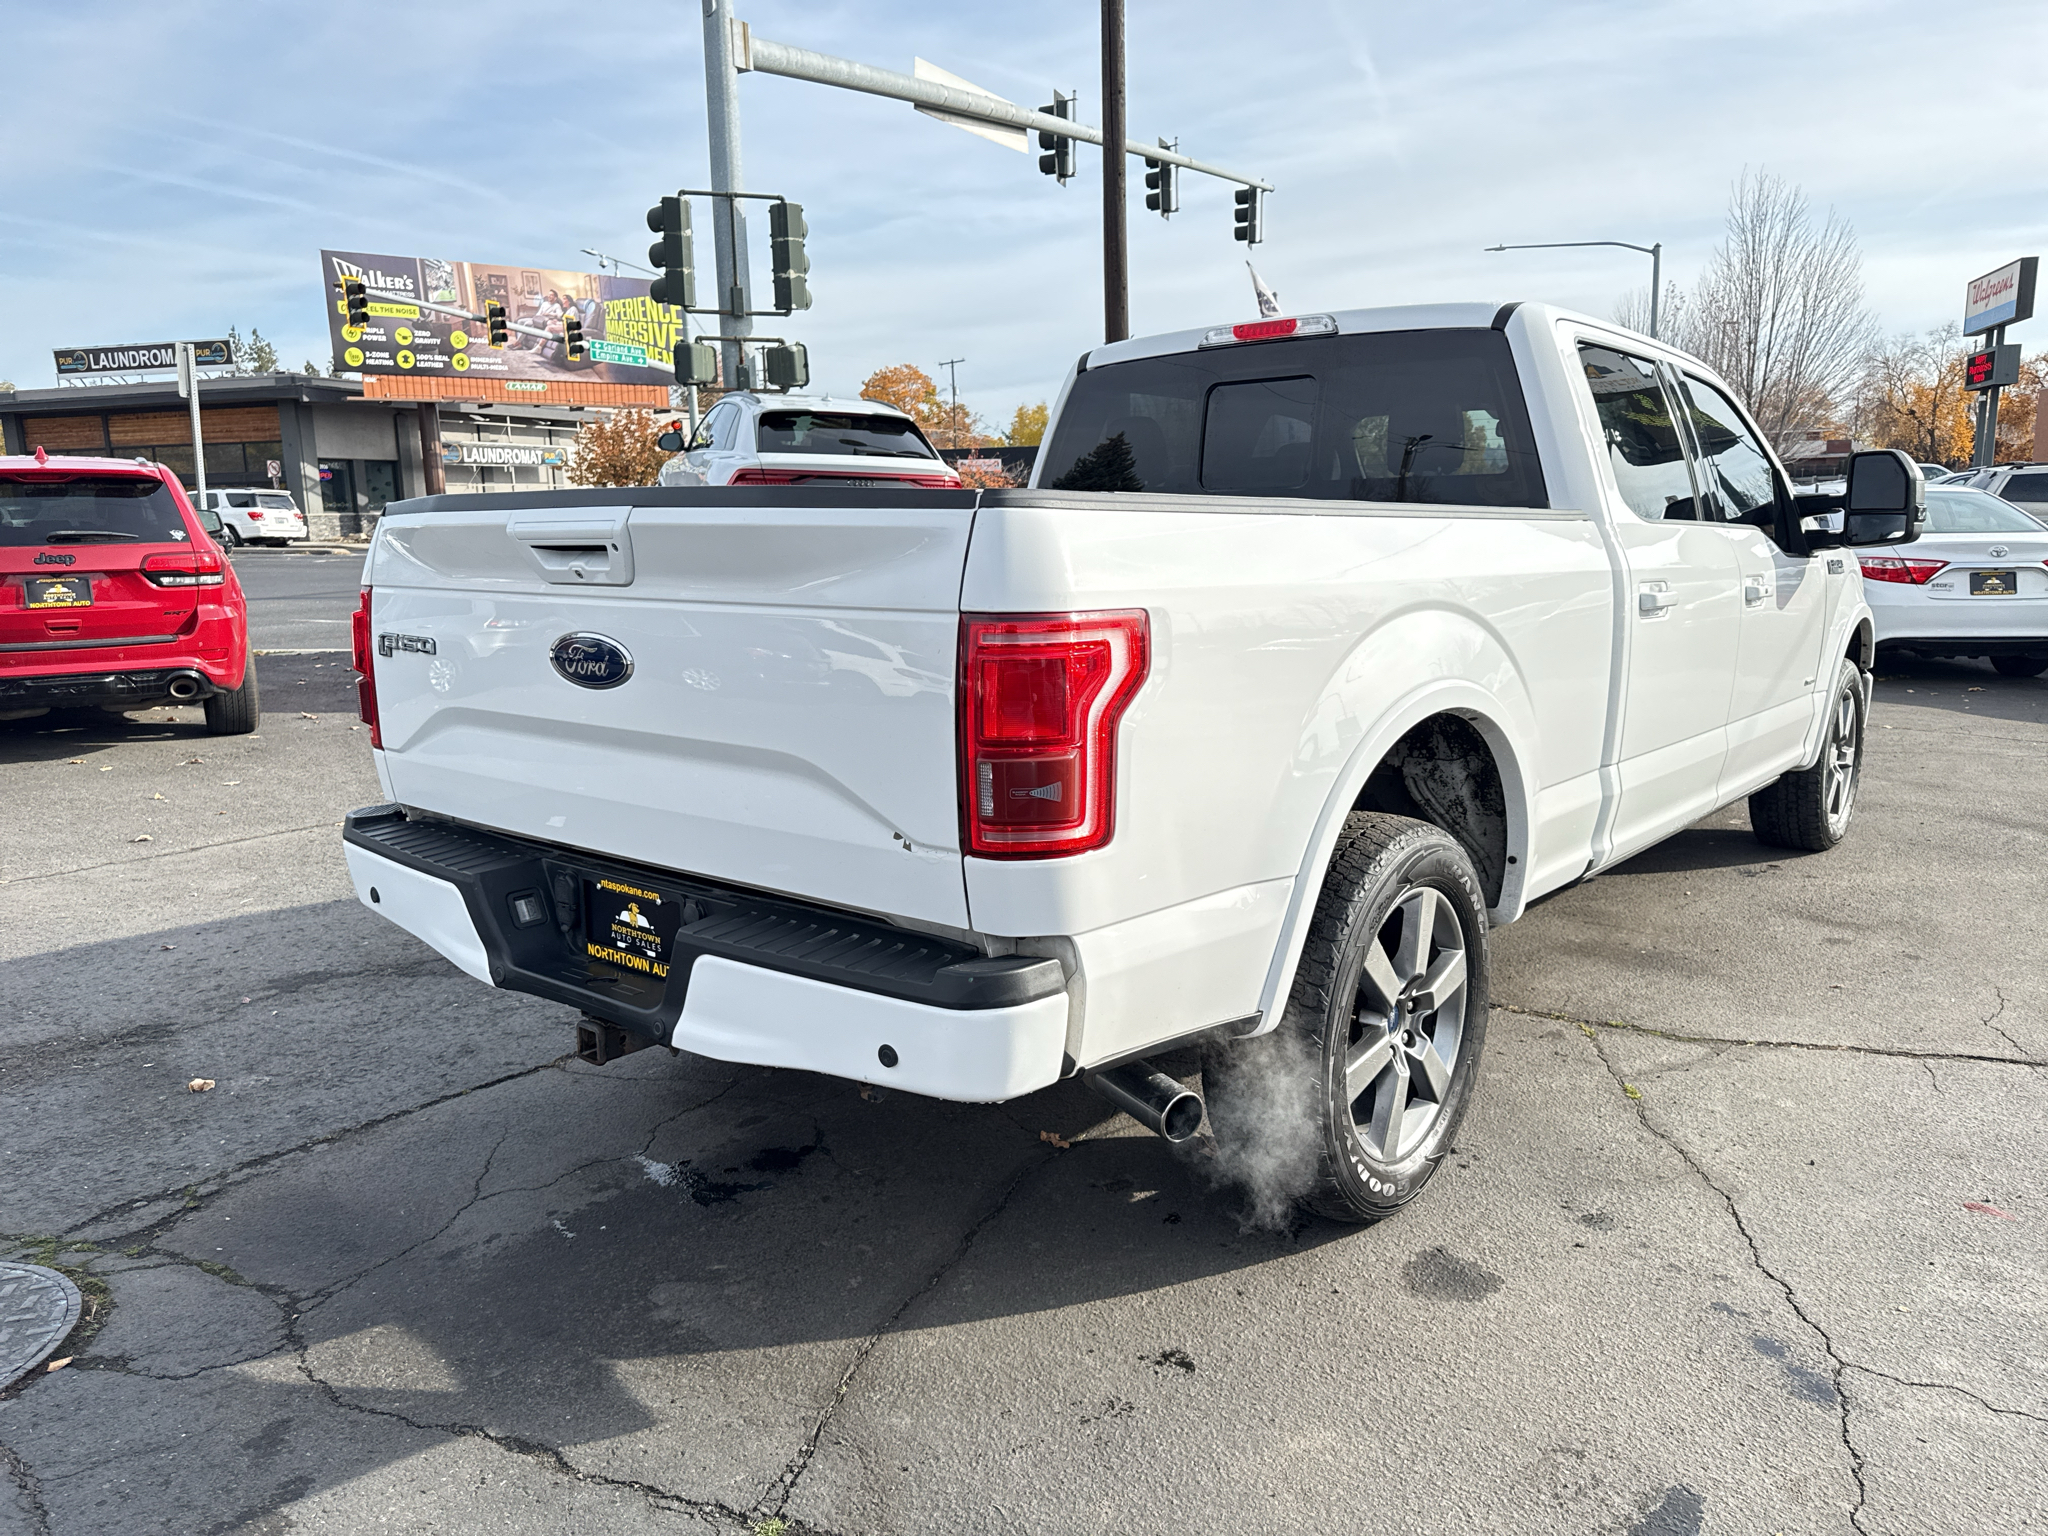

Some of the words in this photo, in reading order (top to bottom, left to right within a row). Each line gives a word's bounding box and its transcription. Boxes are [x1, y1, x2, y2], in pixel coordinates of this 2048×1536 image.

[1972, 272, 2014, 308] Walgreens
[379, 306, 394, 314] THE
[604, 296, 683, 324] EXPERIENCE
[414, 337, 441, 345] GRAVITY
[605, 320, 683, 350] IMMERSIVE
[195, 348, 211, 357] PUR
[416, 353, 434, 361] 100%
[596, 351, 619, 361] Empire
[621, 354, 635, 363] Ave.
[602, 344, 628, 353] Garland
[631, 347, 644, 356] Ave.
[58, 357, 73, 365] PUR
[89, 348, 178, 369] LAUNDROM
[508, 382, 544, 390] LAMAR
[462, 446, 543, 464] LAUNDROMAT
[34, 552, 76, 566] Jeep
[29, 601, 72, 609] NORTHTOWN
[561, 644, 610, 677] Ford
[600, 879, 660, 900] ntaspokane.com
[611, 923, 661, 944] NORTHTOWN
[611, 931, 632, 943] AUTO
[635, 938, 662, 952] SALES
[587, 943, 650, 972] NORTHTOWN
[652, 962, 670, 978] AU
